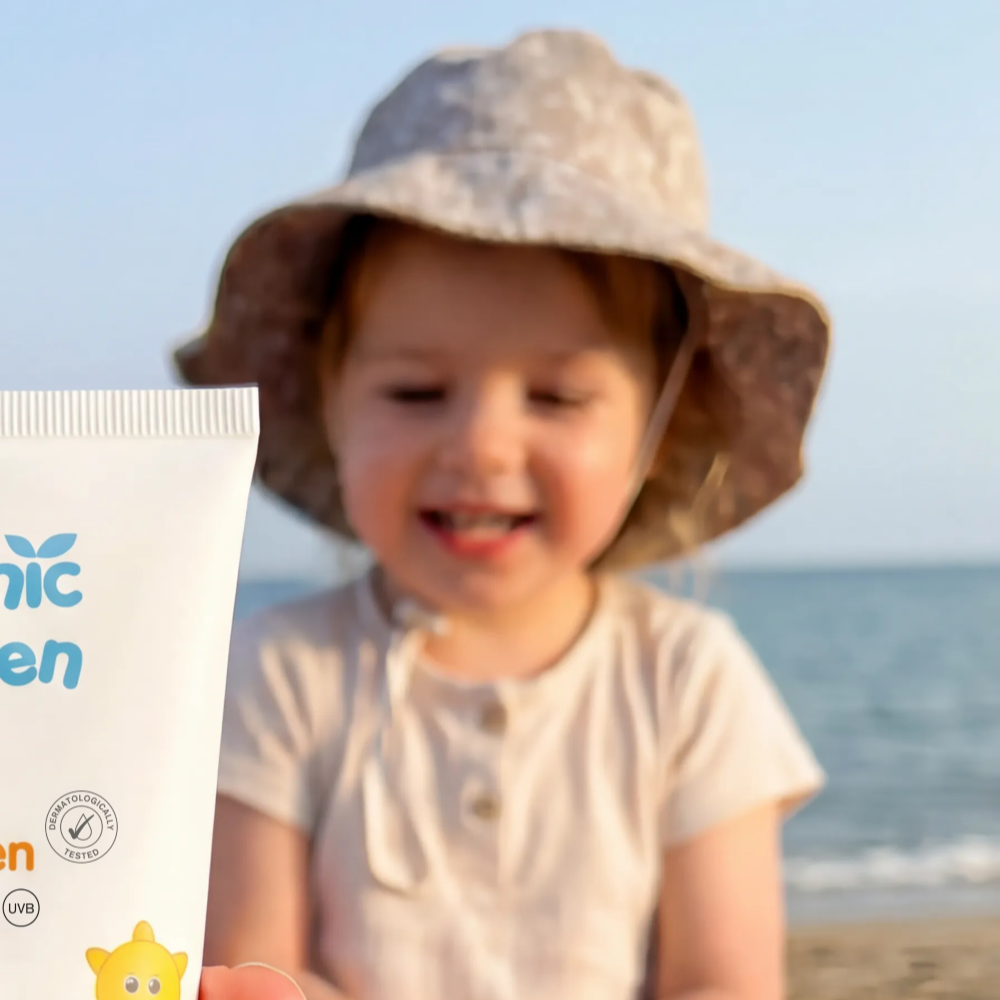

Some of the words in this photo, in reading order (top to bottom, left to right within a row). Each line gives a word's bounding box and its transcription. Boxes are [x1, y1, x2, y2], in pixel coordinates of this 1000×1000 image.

[48, 794, 115, 831] DERMATOLOGICALLY
[63, 847, 100, 860] TESTED
[9, 903, 34, 914] UVB
